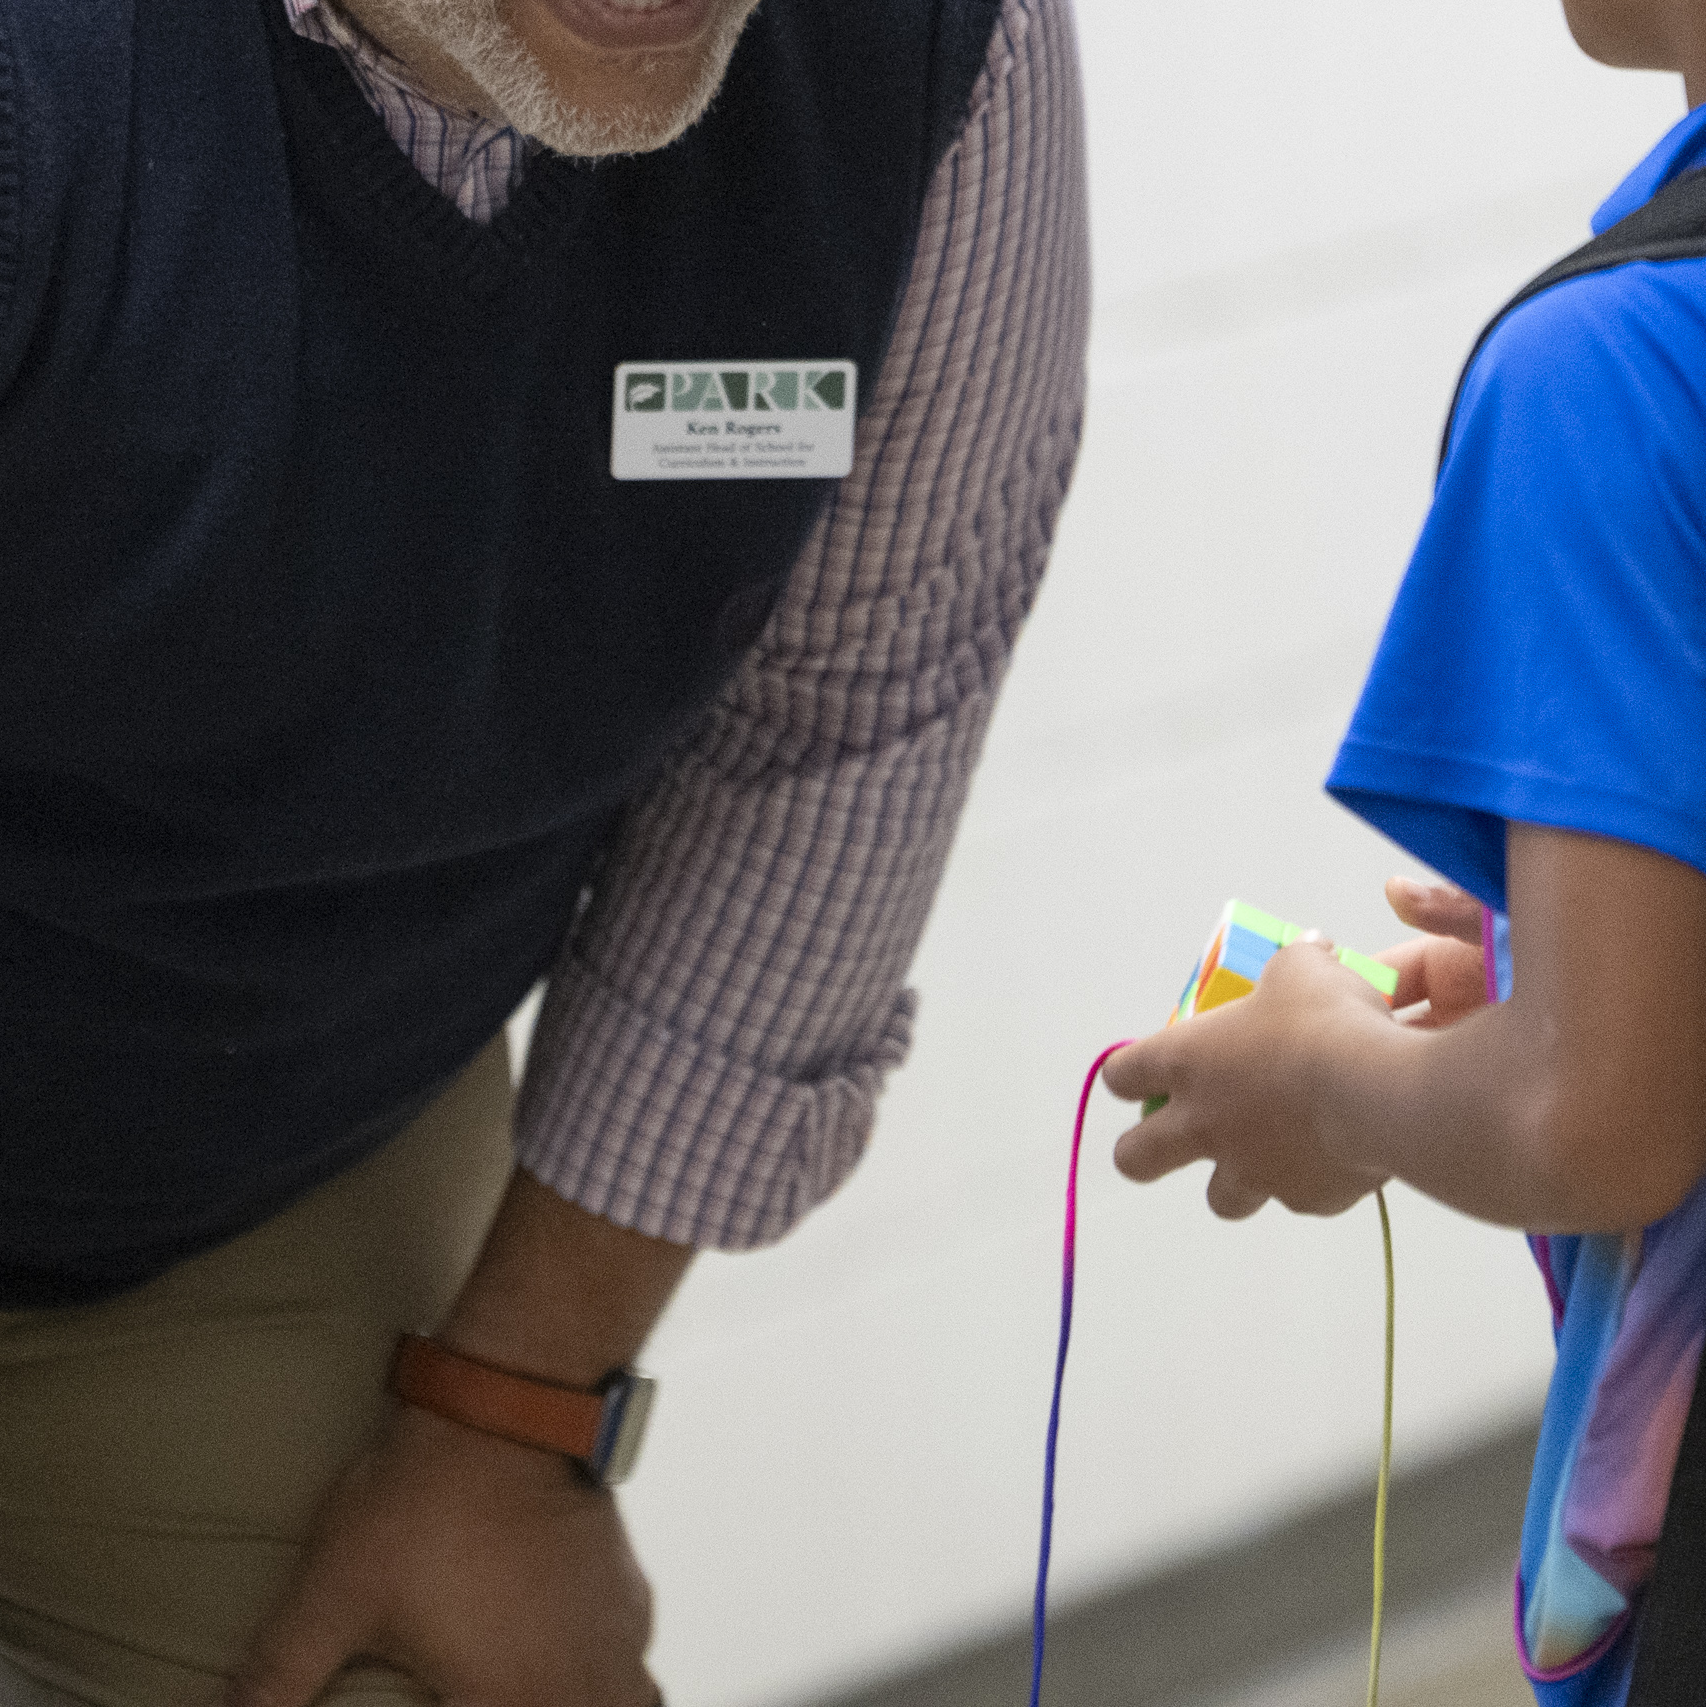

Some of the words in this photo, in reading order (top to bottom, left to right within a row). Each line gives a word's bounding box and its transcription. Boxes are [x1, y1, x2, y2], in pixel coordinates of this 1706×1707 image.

[666, 371, 845, 411] PARK
[686, 421, 719, 435] Ken
[724, 421, 781, 438] Rogers
[706, 442, 735, 453] Head
